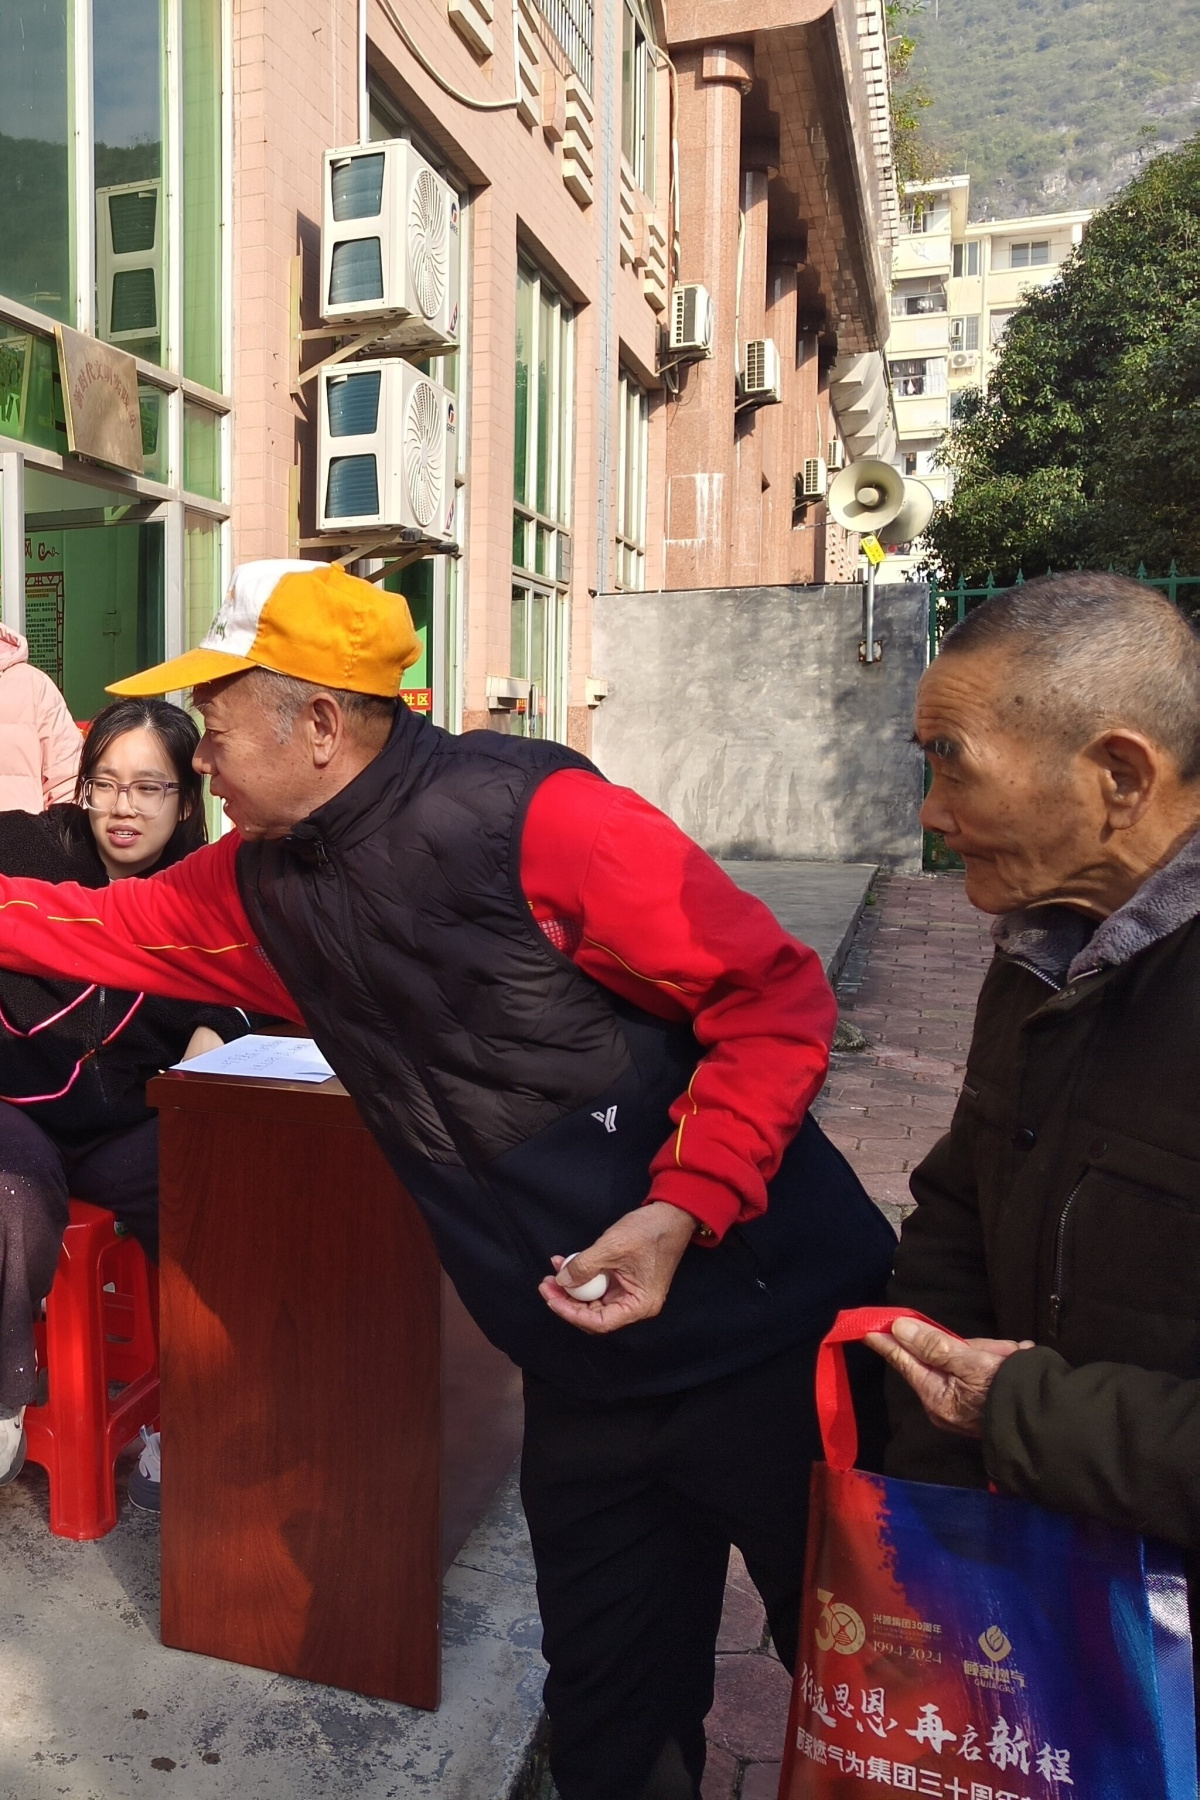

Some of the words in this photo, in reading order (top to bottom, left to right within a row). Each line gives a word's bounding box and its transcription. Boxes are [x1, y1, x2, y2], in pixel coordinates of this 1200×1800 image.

[402, 693, 429, 706] 社区
[873, 1640, 943, 1665] 1994-2024
[963, 1659, 1027, 1688] 顾家燃气
[974, 1678, 997, 1691] GUJIA
